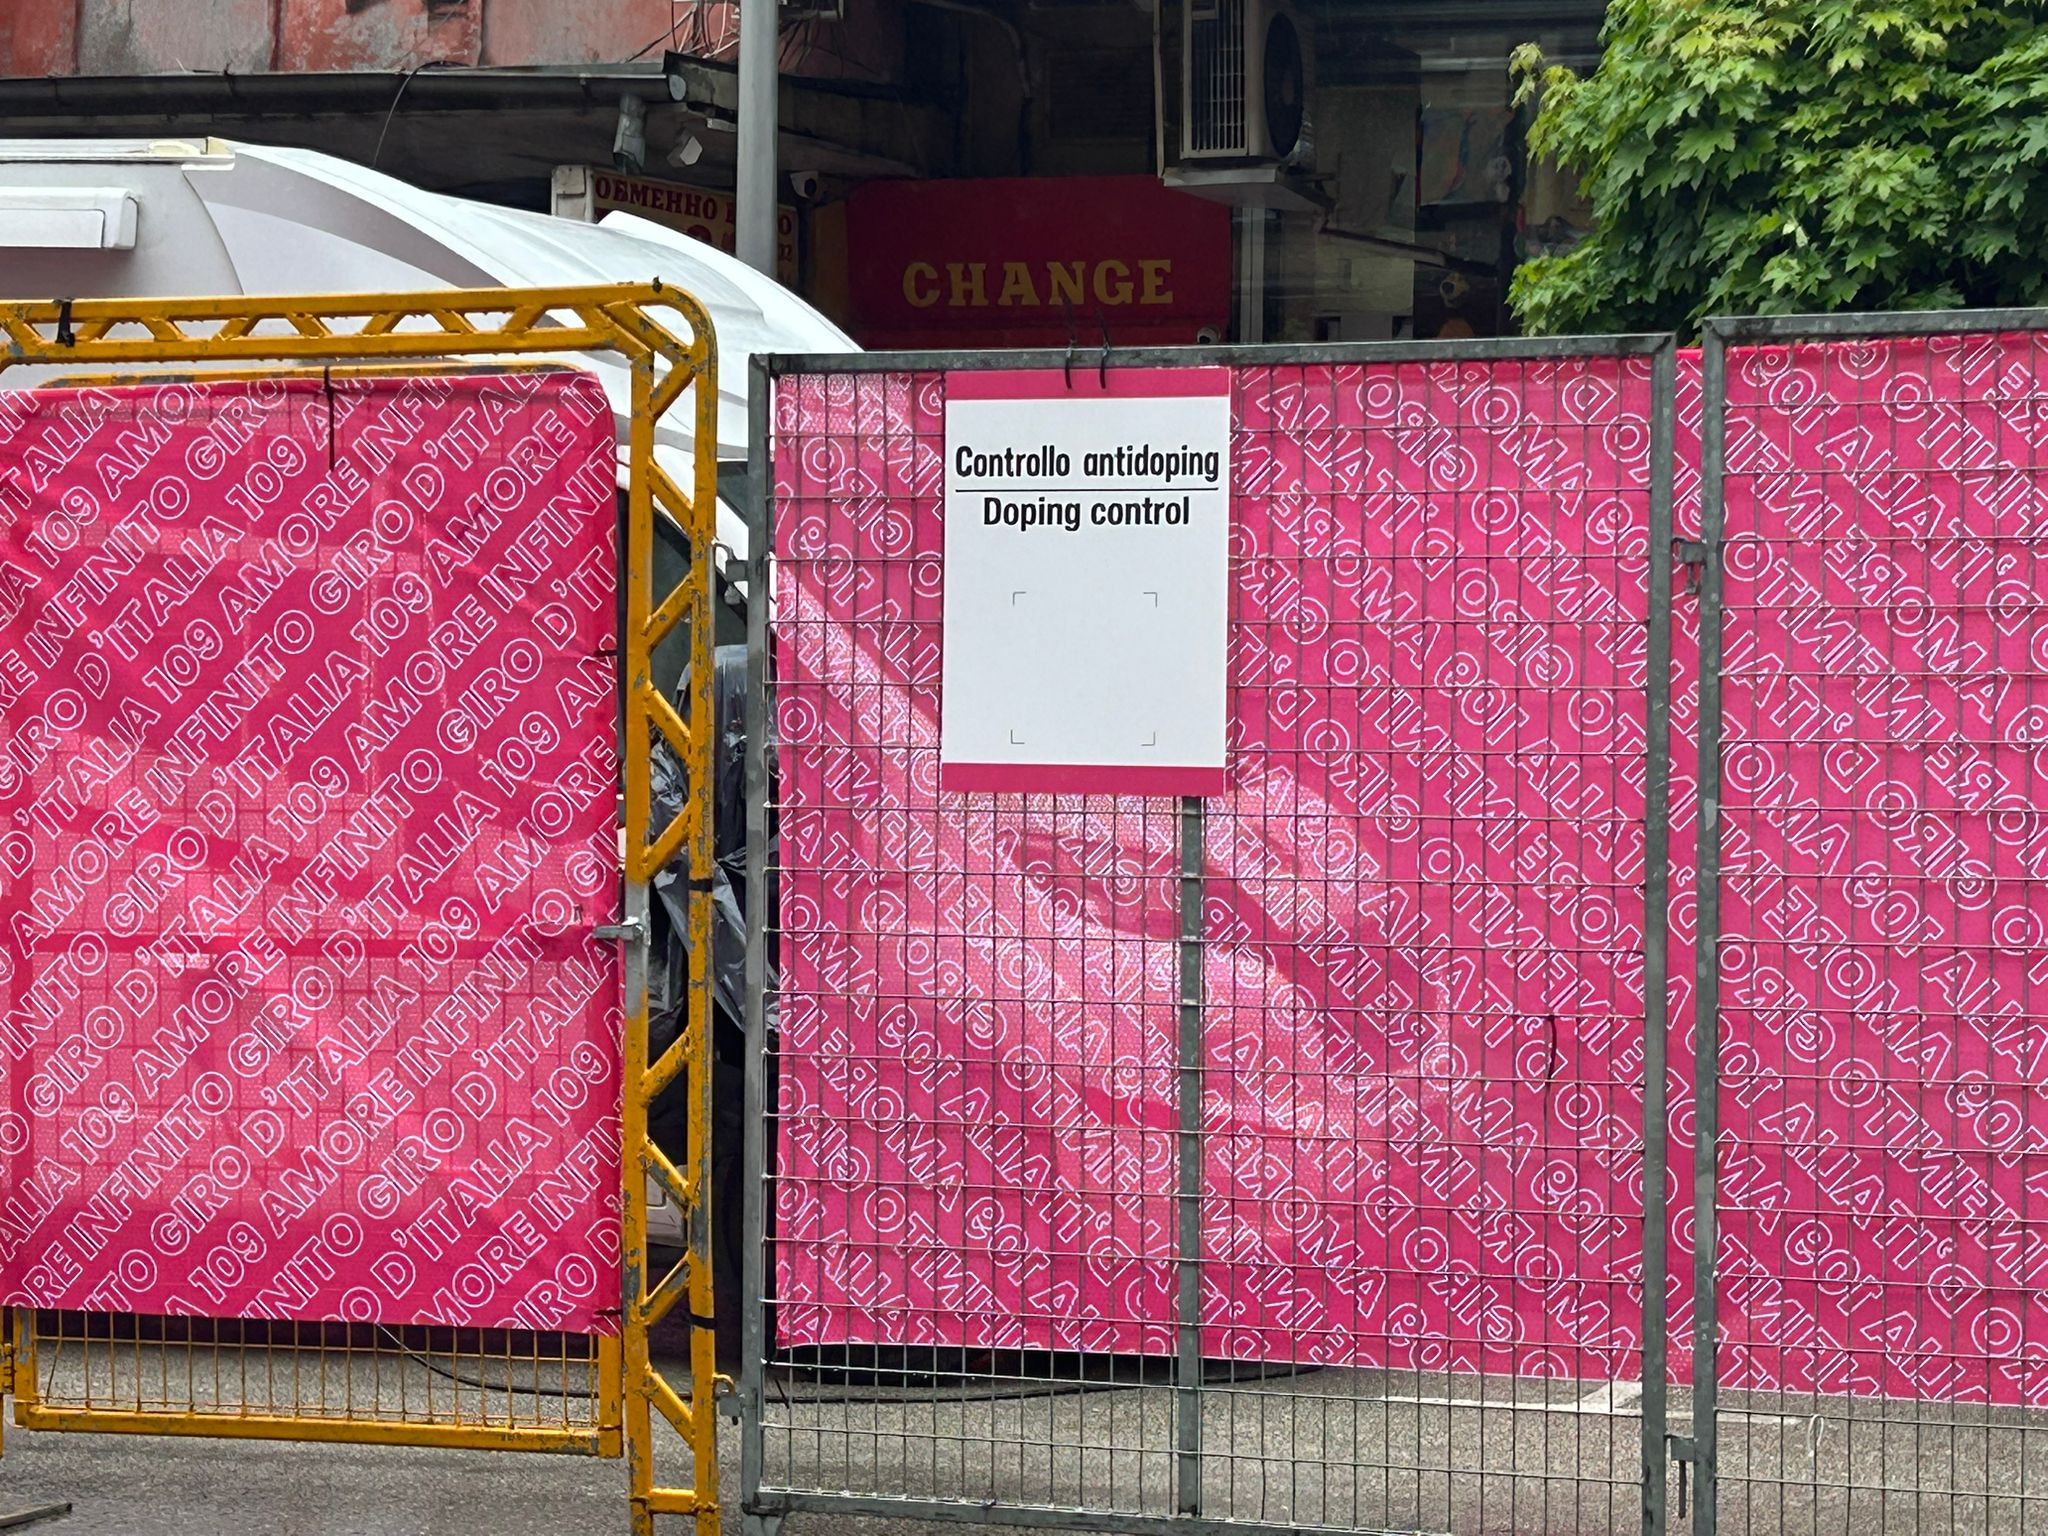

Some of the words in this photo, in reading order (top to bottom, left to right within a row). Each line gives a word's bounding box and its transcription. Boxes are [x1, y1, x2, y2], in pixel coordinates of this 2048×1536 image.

[595, 176, 718, 220] ОБМЕННО
[902, 259, 1174, 308] CHANGE
[24, 486, 100, 568] 109
[96, 383, 210, 501] AMO
[24, 476, 190, 668] INFINITO
[74, 515, 245, 700] D'ITALIA
[225, 435, 306, 522] 109
[955, 445, 1070, 478] Controllo
[1083, 444, 1219, 483] antidoping
[983, 496, 1081, 532] Doping
[1091, 496, 1190, 525] control
[0, 696, 161, 879] D'ITALIA
[142, 618, 223, 703] 109
[219, 457, 370, 635] AMORE
[10, 786, 161, 959] AMORE
[145, 609, 315, 805] INFINITO
[310, 500, 414, 614] GIRO
[24, 1005, 124, 1117] GIRO
[114, 835, 289, 1018] D'ITALIA
[267, 756, 349, 842] 109
[344, 594, 497, 773] AMORE
[479, 436, 617, 613] INFINIT
[103, 826, 208, 937] GIRO
[196, 650, 371, 837] D'ITALIA
[351, 571, 432, 657] 109
[426, 409, 577, 588] AMORE
[60, 1082, 138, 1165] 109
[133, 925, 287, 1099] AMORE
[267, 749, 442, 946] INFINITO
[437, 638, 543, 754] GIRO
[64, 1071, 233, 1260] INFINITO
[228, 966, 333, 1077] GIRO
[322, 790, 500, 977] D'ITALIA
[479, 711, 560, 798] 109
[151, 1145, 250, 1255] GIRO
[240, 975, 419, 1157] D'ITALIA
[400, 897, 480, 983] 109
[474, 735, 617, 913] AMORE
[188, 1221, 267, 1304] 109
[259, 1067, 415, 1239] AMORE
[397, 889, 575, 1087] INFINITO
[358, 1108, 464, 1219] GIRO
[452, 933, 618, 1121] D'ITALIA
[370, 1117, 552, 1299] D'ITALIA
[532, 1041, 610, 1127] 109
[412, 1211, 548, 1328] MORE
